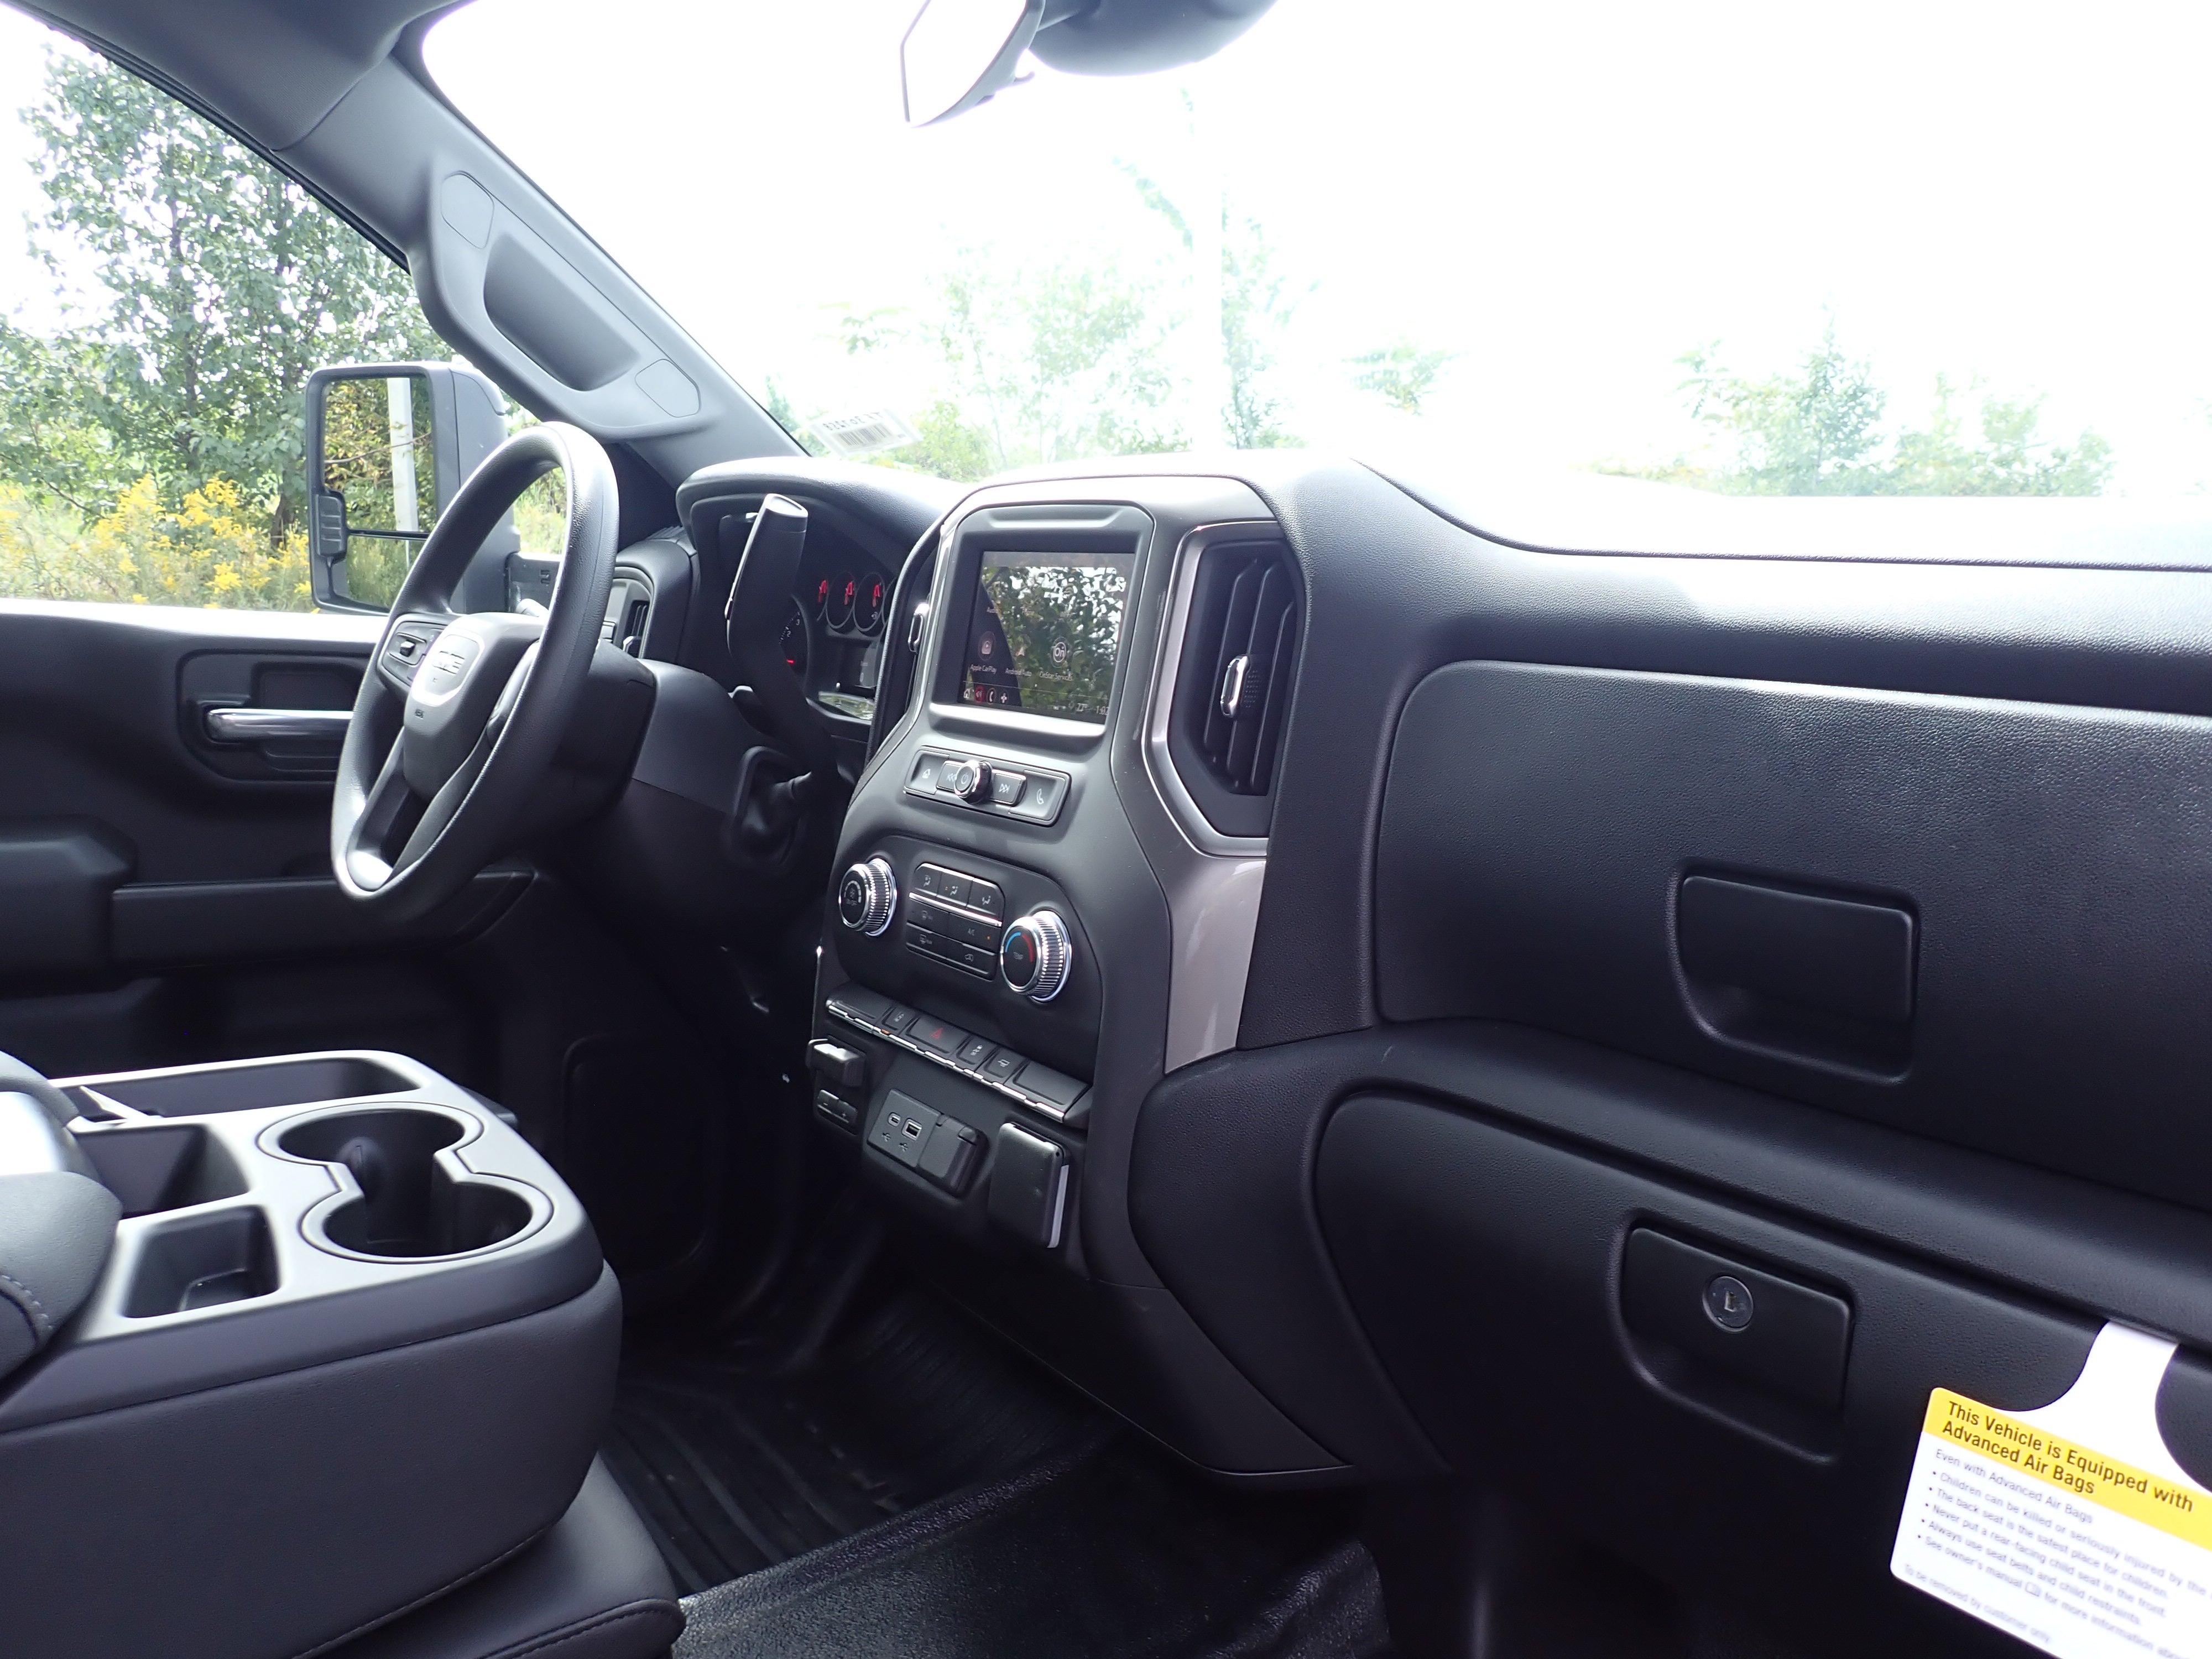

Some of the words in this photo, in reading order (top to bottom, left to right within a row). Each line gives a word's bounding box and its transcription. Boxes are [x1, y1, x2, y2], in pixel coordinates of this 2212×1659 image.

[1936, 1448, 1960, 1467] Even
[1964, 1464, 1986, 1477] with
[1989, 1472, 2043, 1502] Advanced
[2045, 1496, 2062, 1509] Air
[2064, 1504, 2093, 1524] Bags
[1943, 1421, 2020, 1462] Advanced
[2025, 1454, 2048, 1473] Air
[2053, 1465, 2094, 1493] Bags
[1950, 1401, 1979, 1425] This
[1986, 1416, 2041, 1450] Vehicle
[2048, 1442, 2060, 1458] is
[2067, 1450, 2147, 1493] Equipped
[2155, 1488, 2192, 1511] with
